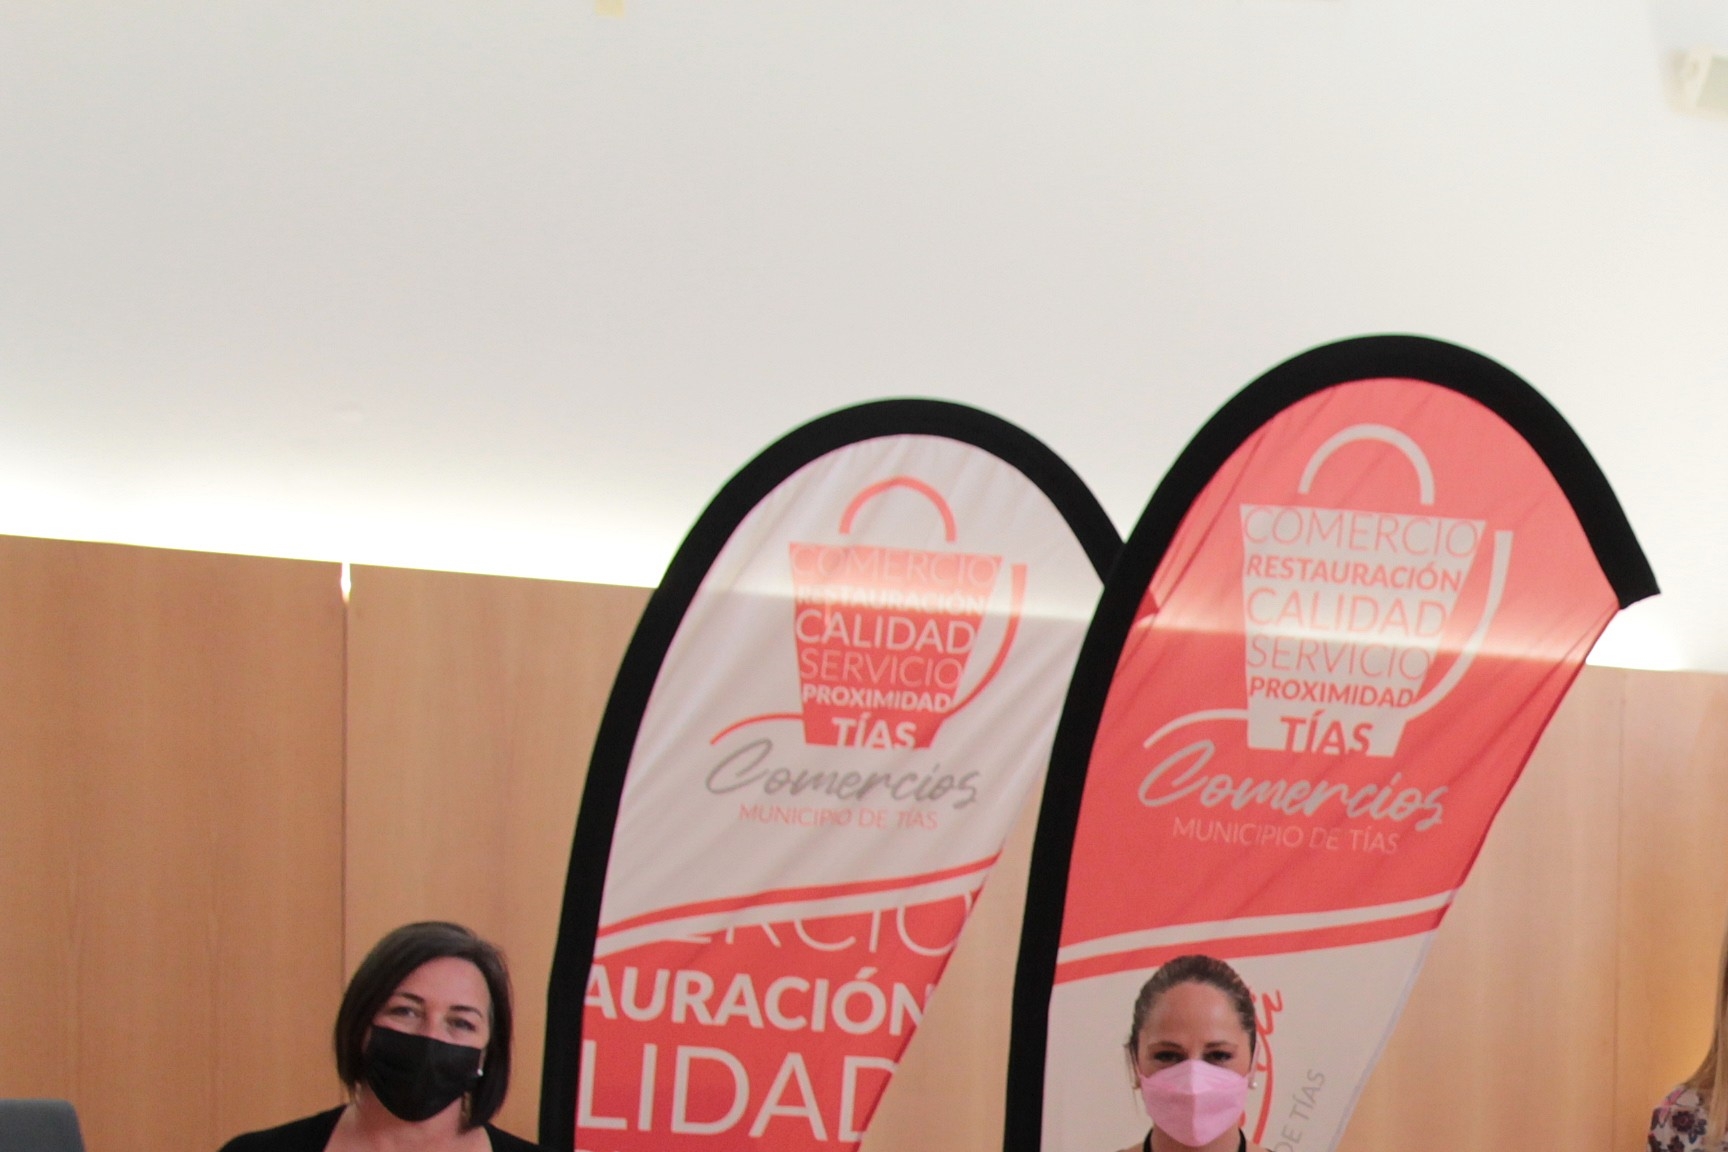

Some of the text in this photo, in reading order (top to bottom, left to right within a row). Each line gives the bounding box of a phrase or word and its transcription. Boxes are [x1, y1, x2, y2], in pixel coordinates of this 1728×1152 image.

[1244, 507, 1479, 558] COMERCIO
[793, 547, 998, 587] COMERCIO
[1247, 554, 1462, 592] RESTAURACIÓN
[796, 609, 976, 655] CALIDAD
[1248, 587, 1447, 638] CALIDAD
[800, 648, 963, 689] SERVICIO
[1247, 635, 1430, 681] SERVICIO
[803, 683, 950, 713] PROXIMIDAD
[1249, 676, 1414, 708] PROXIMIDAD
[831, 712, 918, 750] TÍAS
[1281, 709, 1374, 755] TÍAS
[705, 738, 980, 810] Comercios
[1138, 739, 1449, 832] Comercios
[739, 803, 938, 830] MUNICIPIO DE TÍAS
[1172, 816, 1399, 854] MUNICIPIO DE TÍAS
